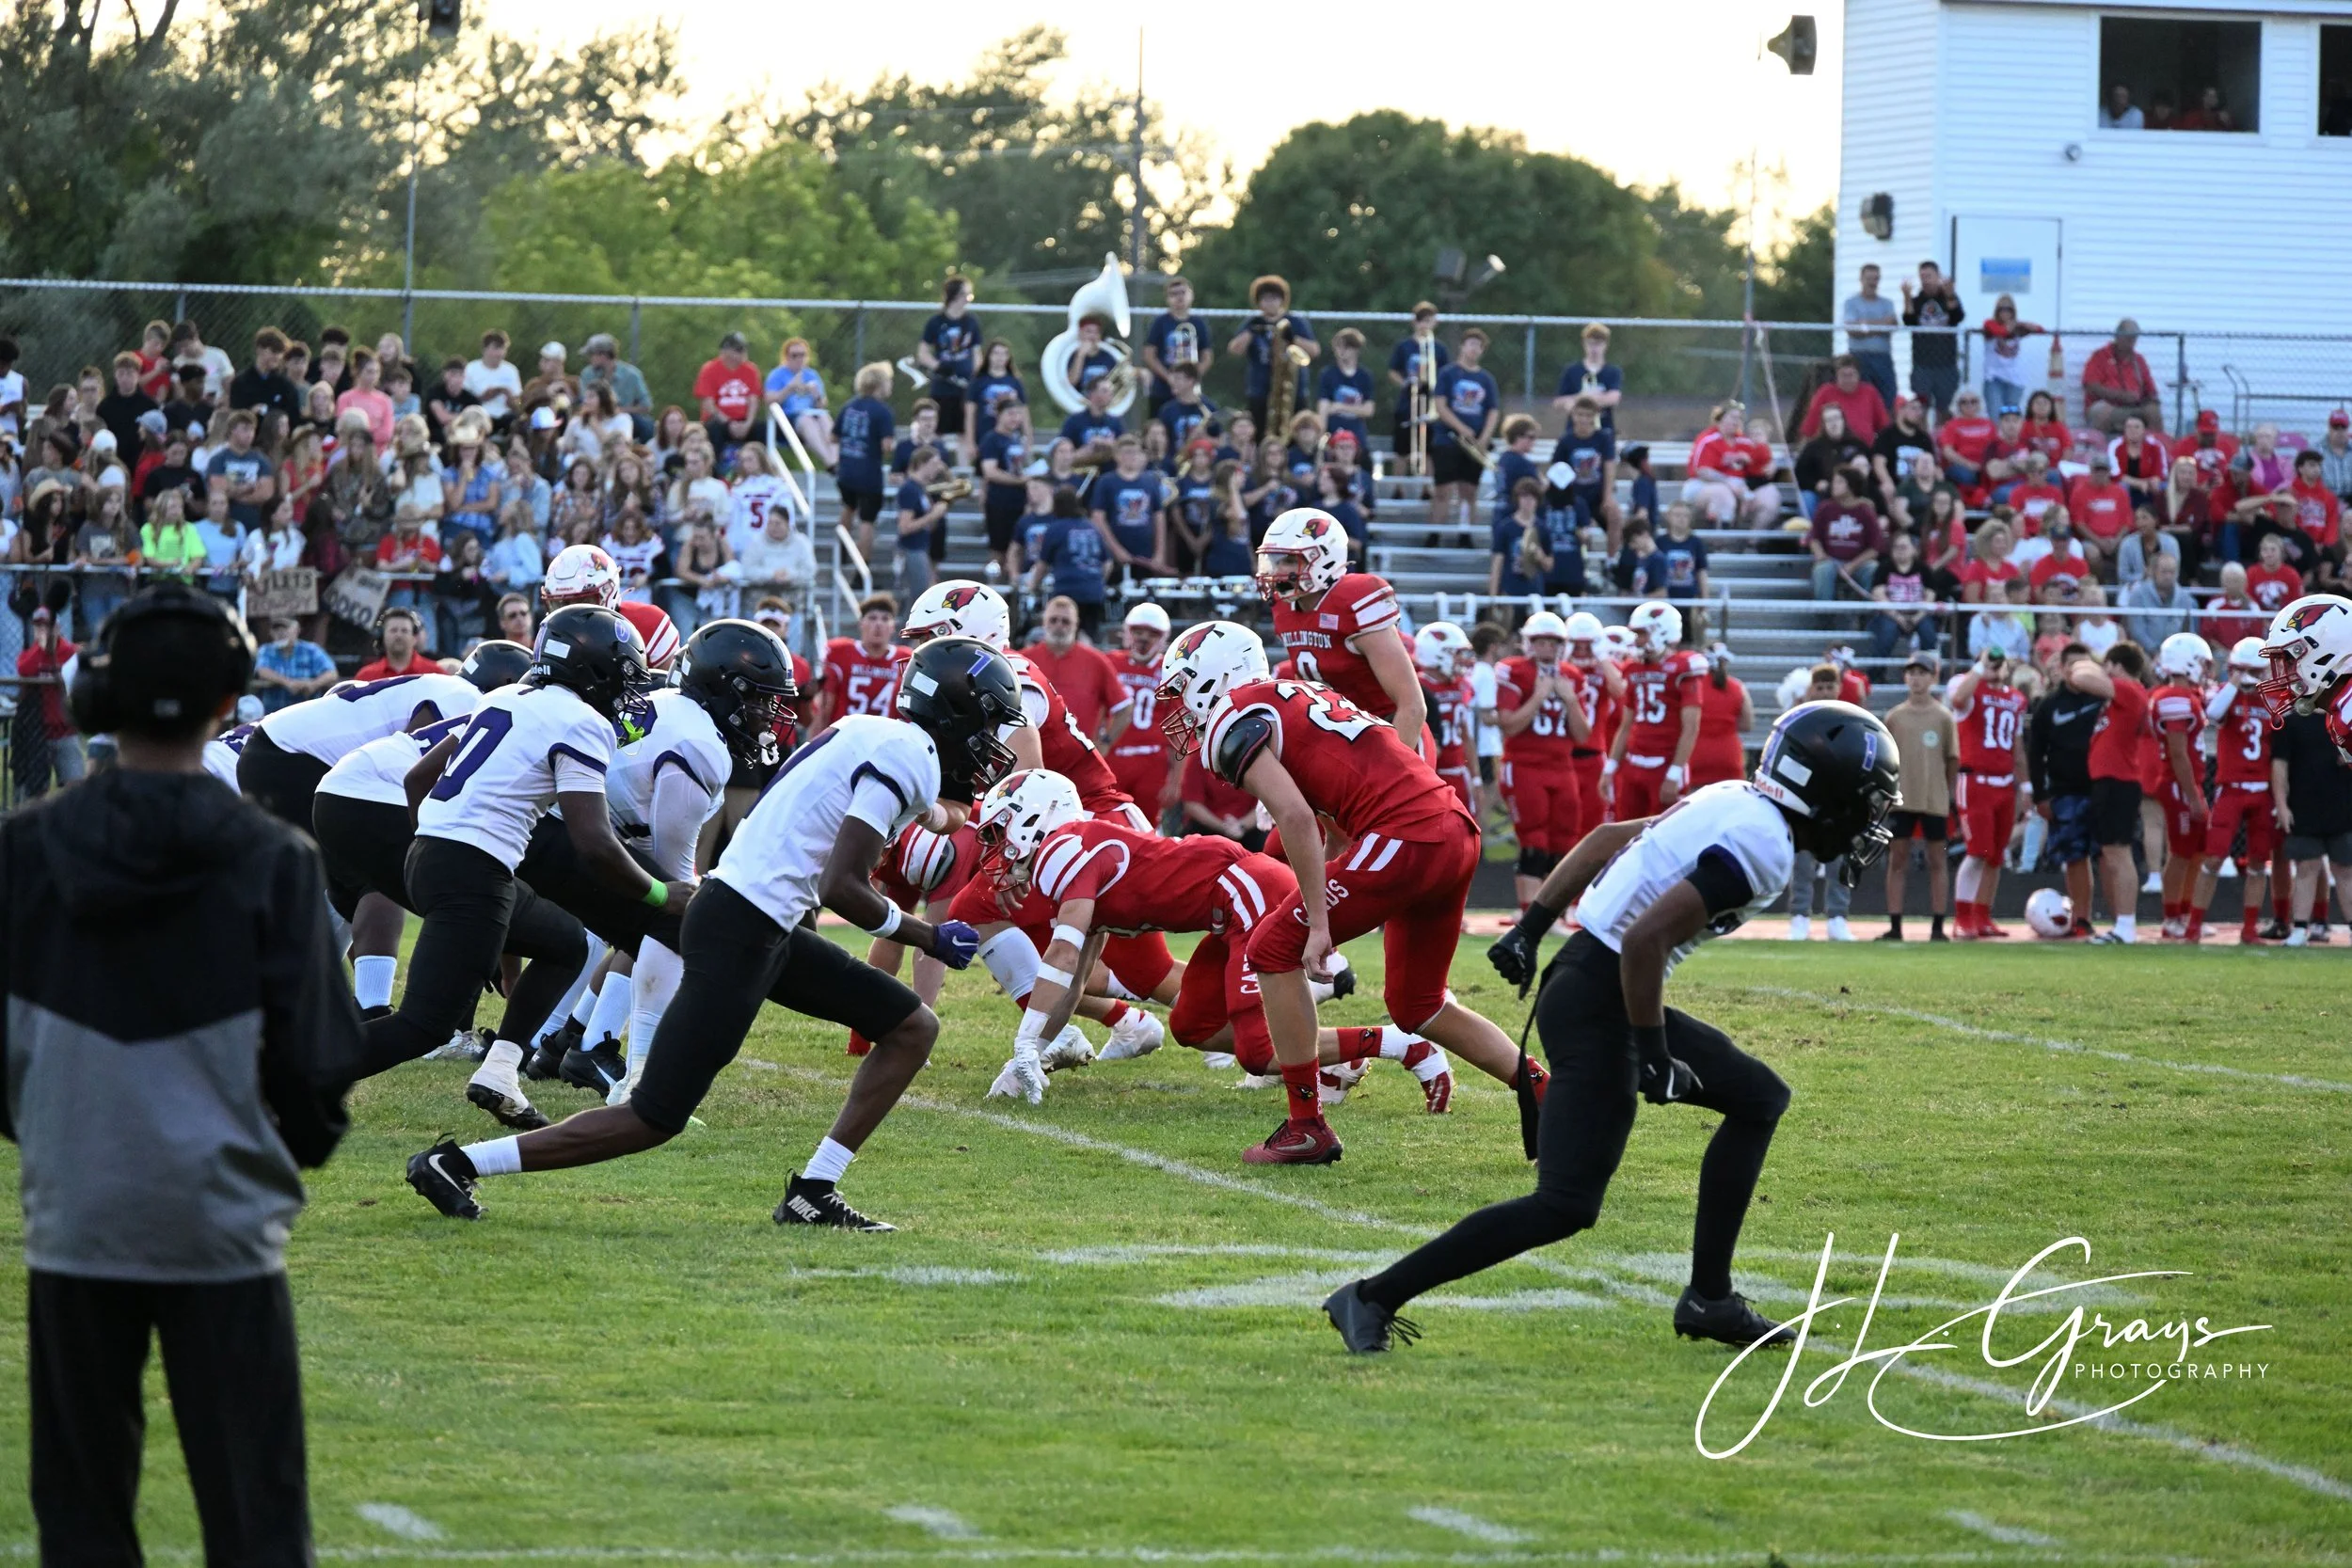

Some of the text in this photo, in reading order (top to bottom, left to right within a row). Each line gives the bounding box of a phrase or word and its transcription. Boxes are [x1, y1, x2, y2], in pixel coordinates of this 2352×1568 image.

[750, 500, 764, 529] 5
[966, 648, 994, 677] 7
[848, 676, 894, 718] 54
[1635, 683, 1667, 724] 15
[1982, 706, 2015, 751] 10
[2240, 718, 2264, 762] 3
[787, 1194, 821, 1223] NIKE
